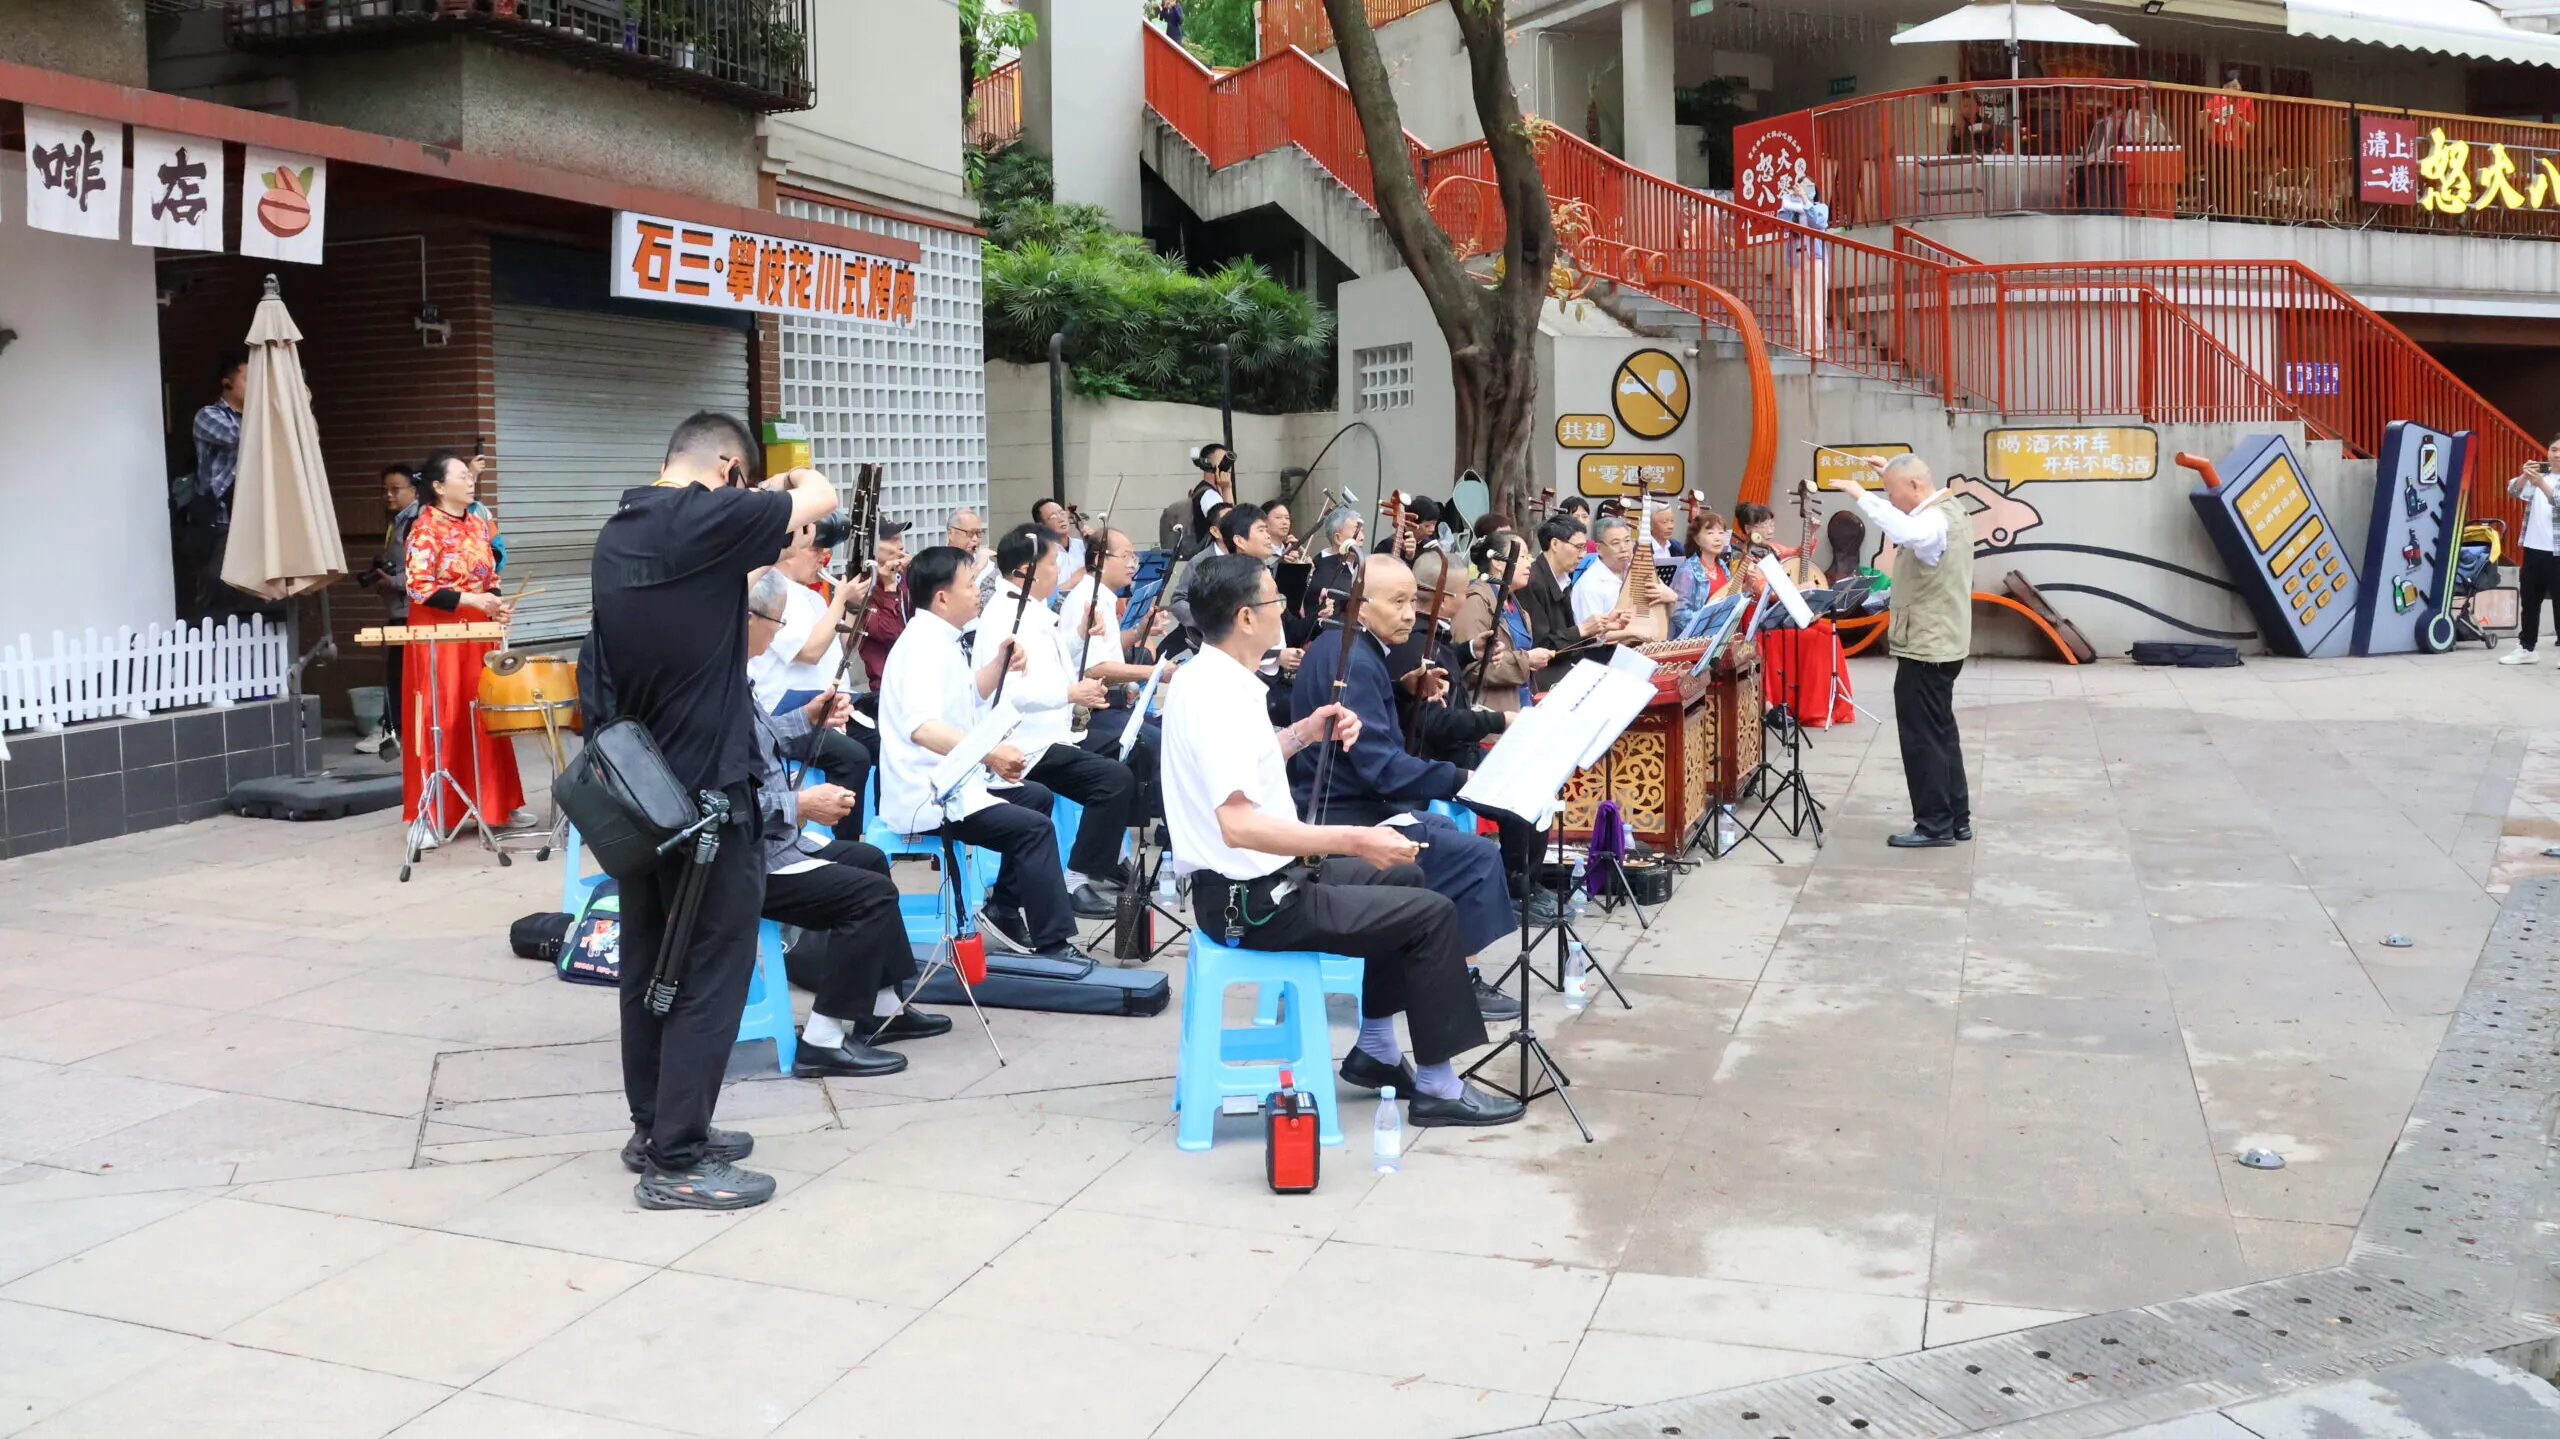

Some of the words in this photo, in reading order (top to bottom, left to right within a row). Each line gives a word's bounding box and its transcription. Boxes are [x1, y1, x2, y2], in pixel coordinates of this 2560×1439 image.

[2367, 130, 2410, 159] 请上
[2367, 165, 2410, 194] 二楼
[1562, 421, 1608, 441] 共建
[1997, 432, 2111, 454] 喝酒不开车
[2042, 454, 2150, 475] 开车不喝酒
